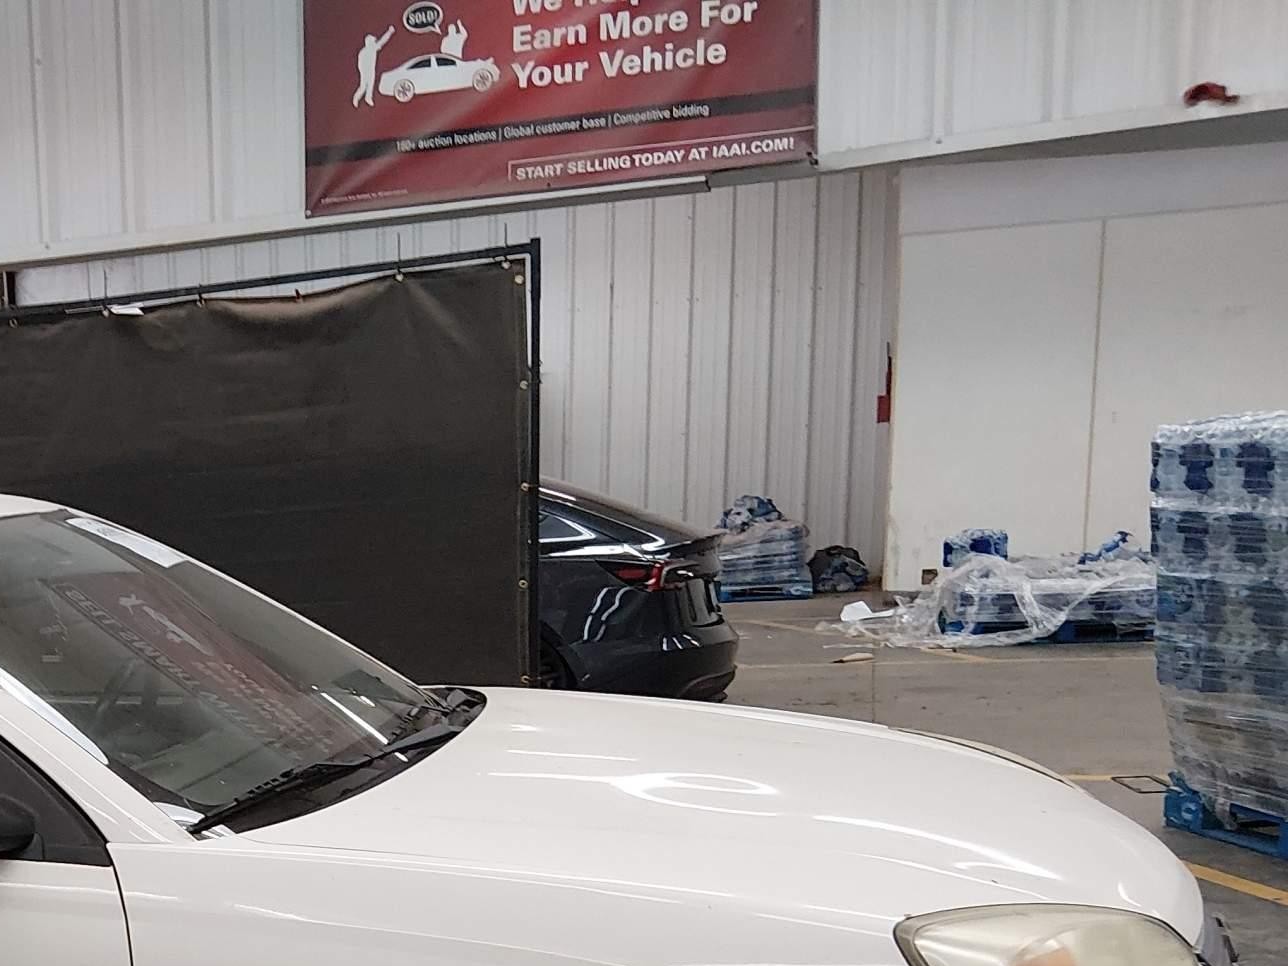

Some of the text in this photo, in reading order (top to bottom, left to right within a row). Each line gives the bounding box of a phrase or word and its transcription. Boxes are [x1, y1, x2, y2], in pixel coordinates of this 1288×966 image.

[512, 0, 758, 52] Earn More For
[511, 38, 727, 89] Your Vehicle
[417, 135, 453, 150] auction
[454, 130, 497, 147] locations
[503, 124, 535, 139] Global
[535, 120, 581, 136] customer
[582, 116, 607, 130] base
[613, 107, 671, 126] Competitive
[672, 104, 710, 120] bidding
[515, 136, 795, 182] START SELLING TODAY AT IAAI.COM!
